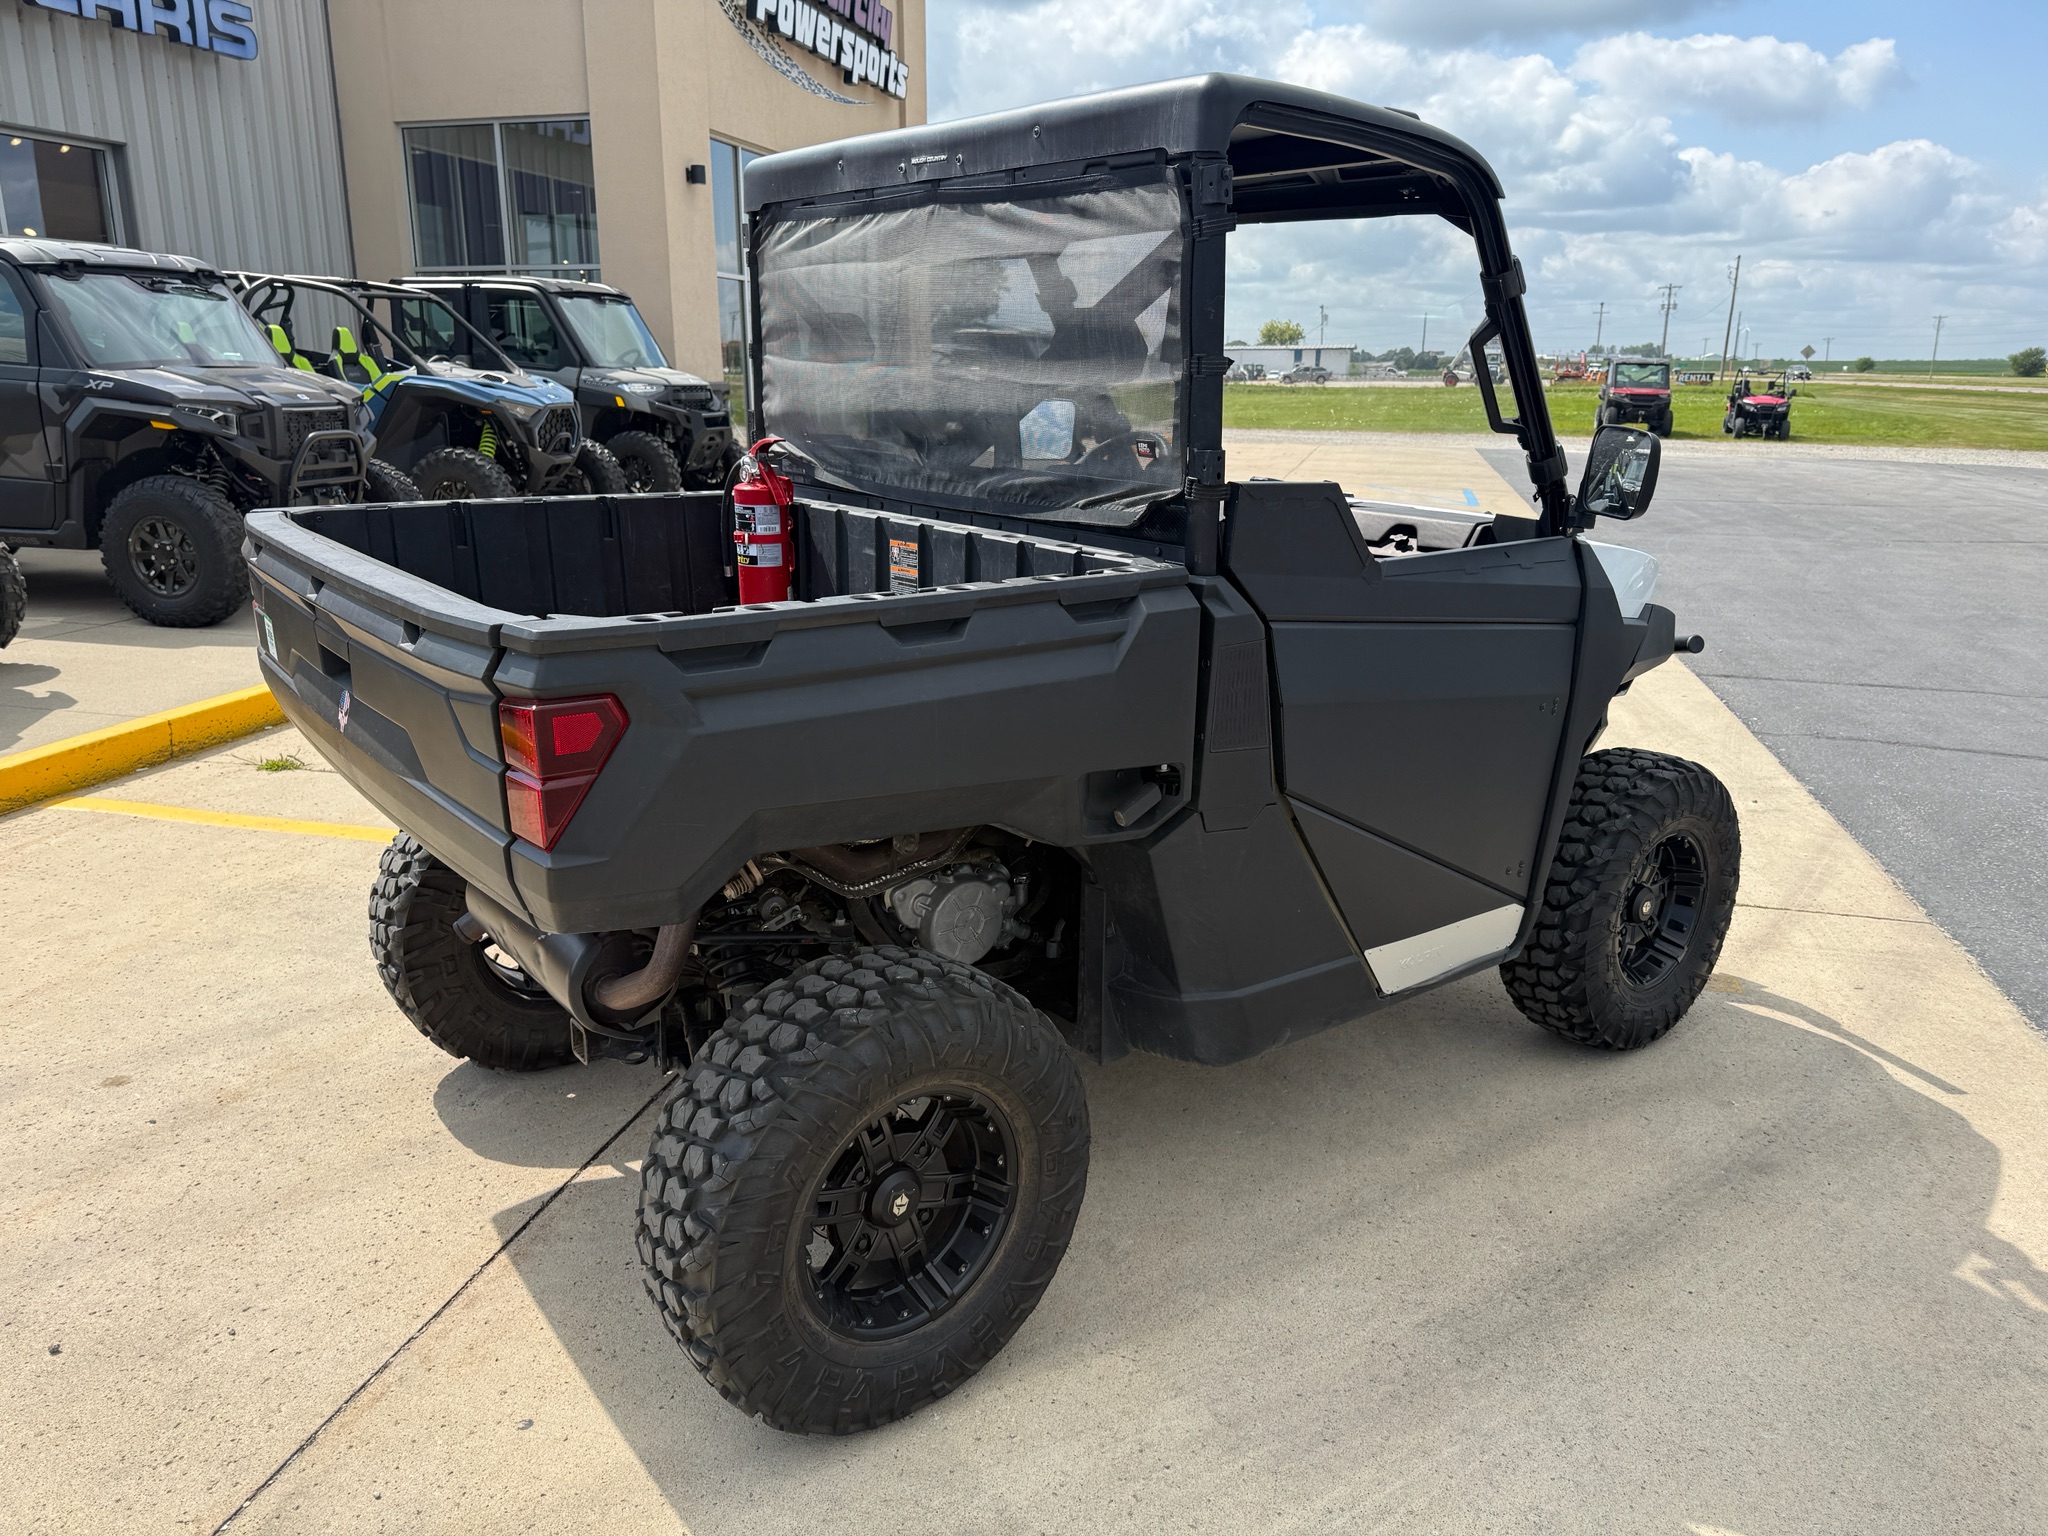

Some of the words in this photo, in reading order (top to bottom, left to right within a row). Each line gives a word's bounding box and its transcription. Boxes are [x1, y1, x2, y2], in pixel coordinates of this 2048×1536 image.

[84, 378, 115, 390] XP
[1678, 374, 1712, 382] RENTAL
[289, 421, 343, 433] POLARIS
